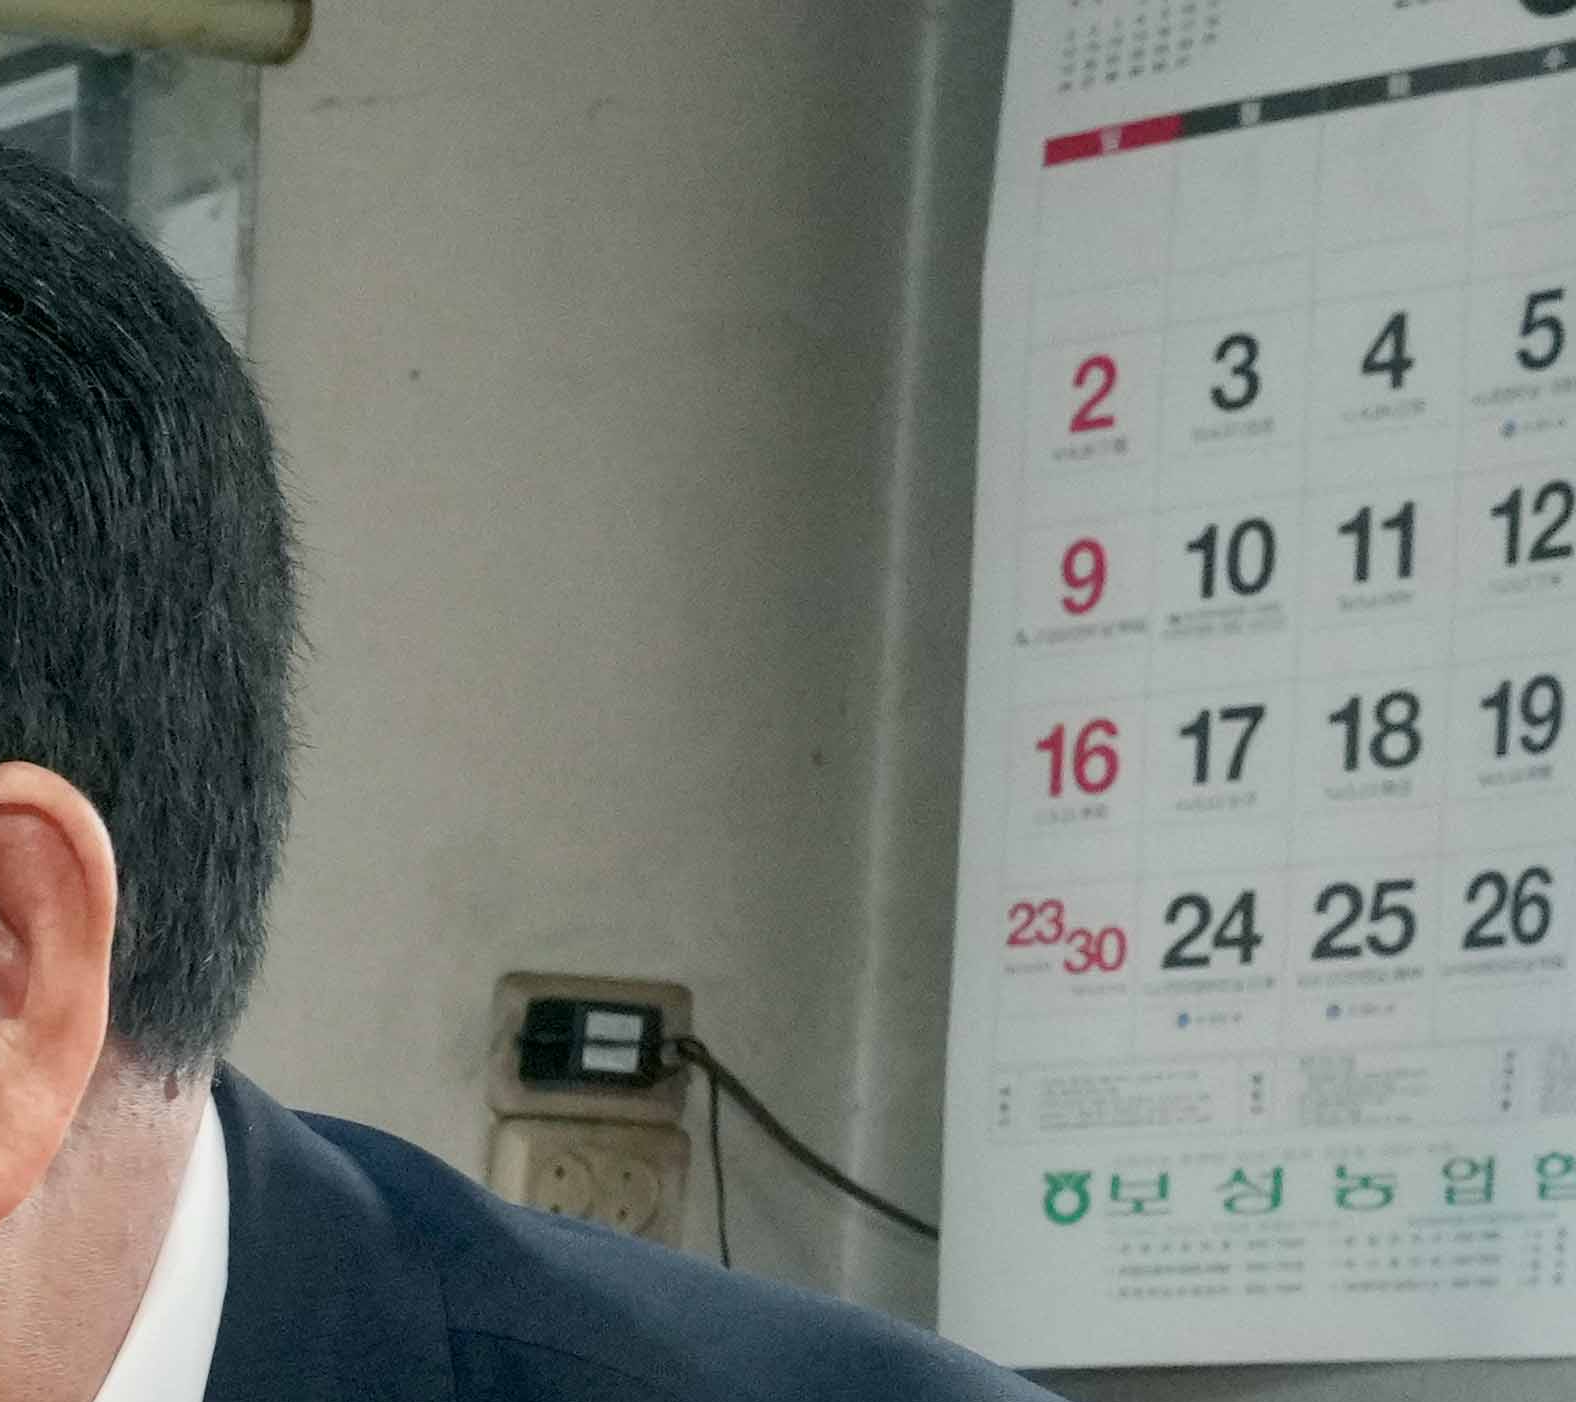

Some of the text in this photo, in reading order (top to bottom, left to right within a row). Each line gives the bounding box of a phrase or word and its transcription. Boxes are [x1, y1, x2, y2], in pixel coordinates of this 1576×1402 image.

[1070, 287, 1565, 433] 2 3 4 5
[1061, 480, 1574, 615] 9 10 11 12
[1036, 675, 1564, 797] 16 17 18 19
[1007, 867, 1552, 973] 23 30 24 25 26
